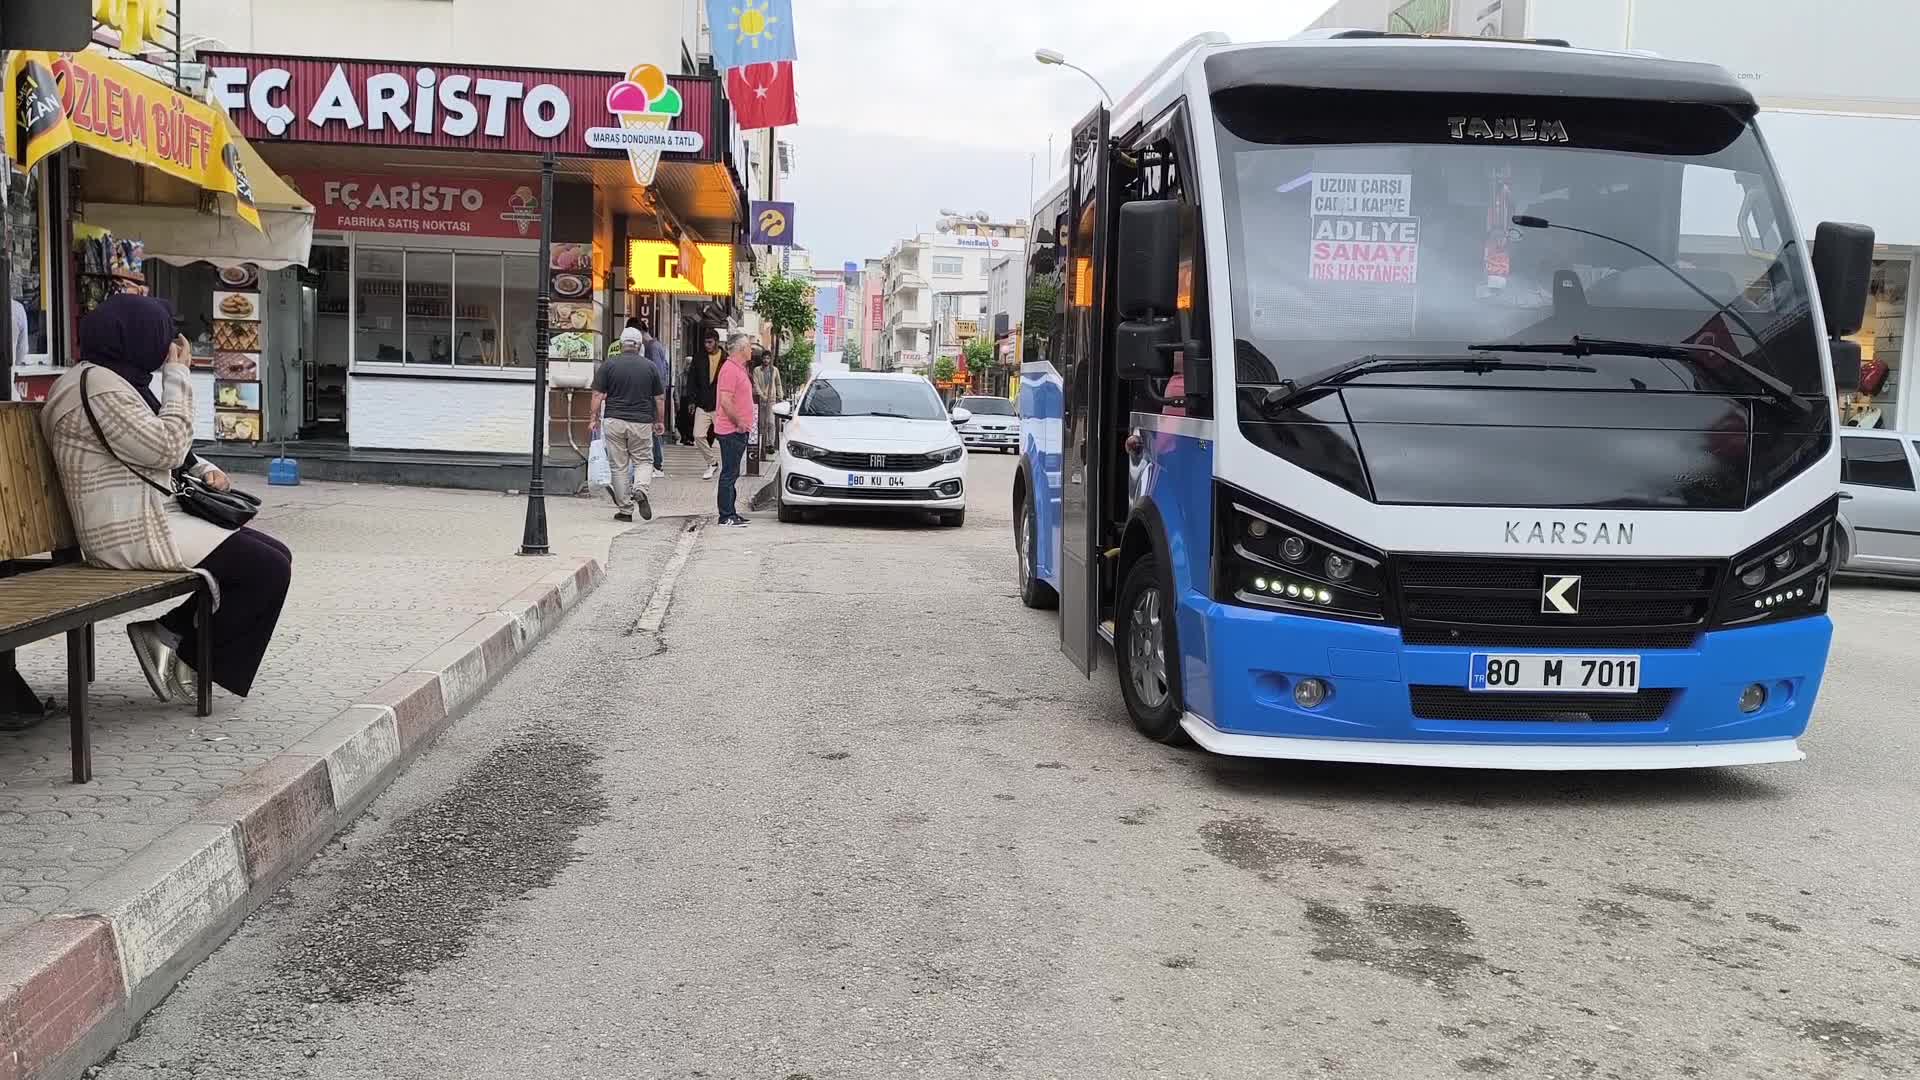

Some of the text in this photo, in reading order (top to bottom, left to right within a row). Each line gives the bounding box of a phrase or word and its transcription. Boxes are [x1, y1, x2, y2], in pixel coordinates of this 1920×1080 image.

[1448, 117, 1569, 142] TANEM
[593, 132, 620, 145] MARAŞ
[622, 134, 666, 145] DONDURMA
[1320, 177, 1357, 193] UZUN
[324, 181, 361, 211] FÇ
[387, 218, 420, 232] SATIŞ
[422, 220, 471, 232] NOKTASI
[870, 455, 886, 467] FIAT
[854, 476, 904, 486] 80 KU 044
[1504, 521, 1634, 545] KARSAN
[1473, 659, 1636, 687] TR 80 M 7011
